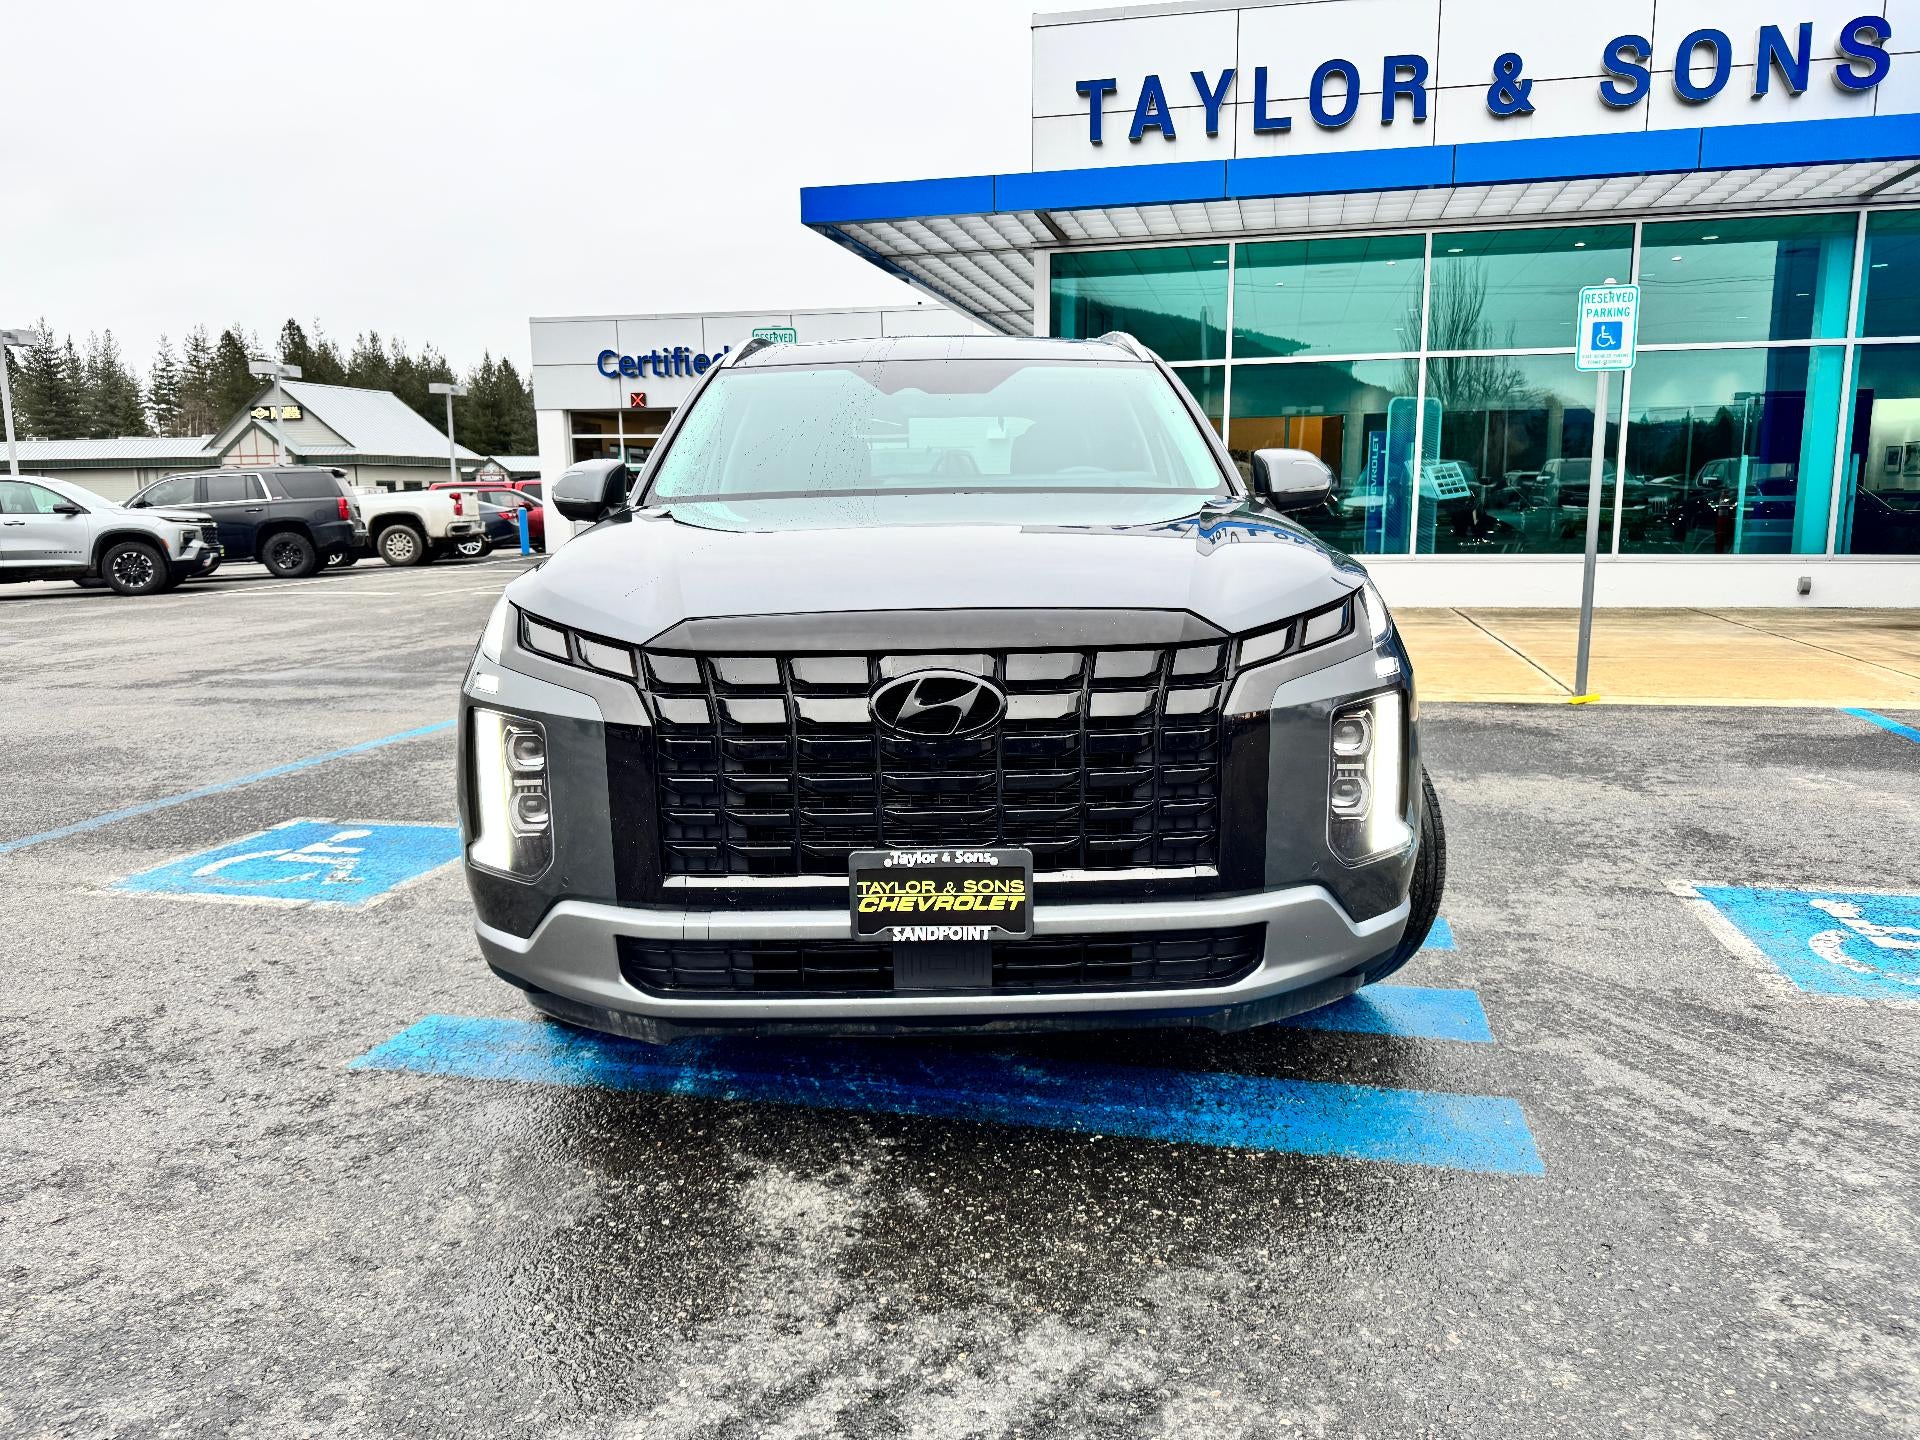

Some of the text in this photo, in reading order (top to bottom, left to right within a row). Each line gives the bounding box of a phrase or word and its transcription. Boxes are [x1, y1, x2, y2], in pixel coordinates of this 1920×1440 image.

[1075, 15, 1892, 145] TAYLOR & SONS
[1584, 291, 1634, 304] RESERVED
[1586, 306, 1631, 318] PARKING
[890, 851, 991, 867] Taylor & Sons
[857, 879, 1025, 895] TAYLOR & SONS
[858, 895, 1026, 913] CHEVROLET
[892, 926, 992, 942] SANDPOINT
